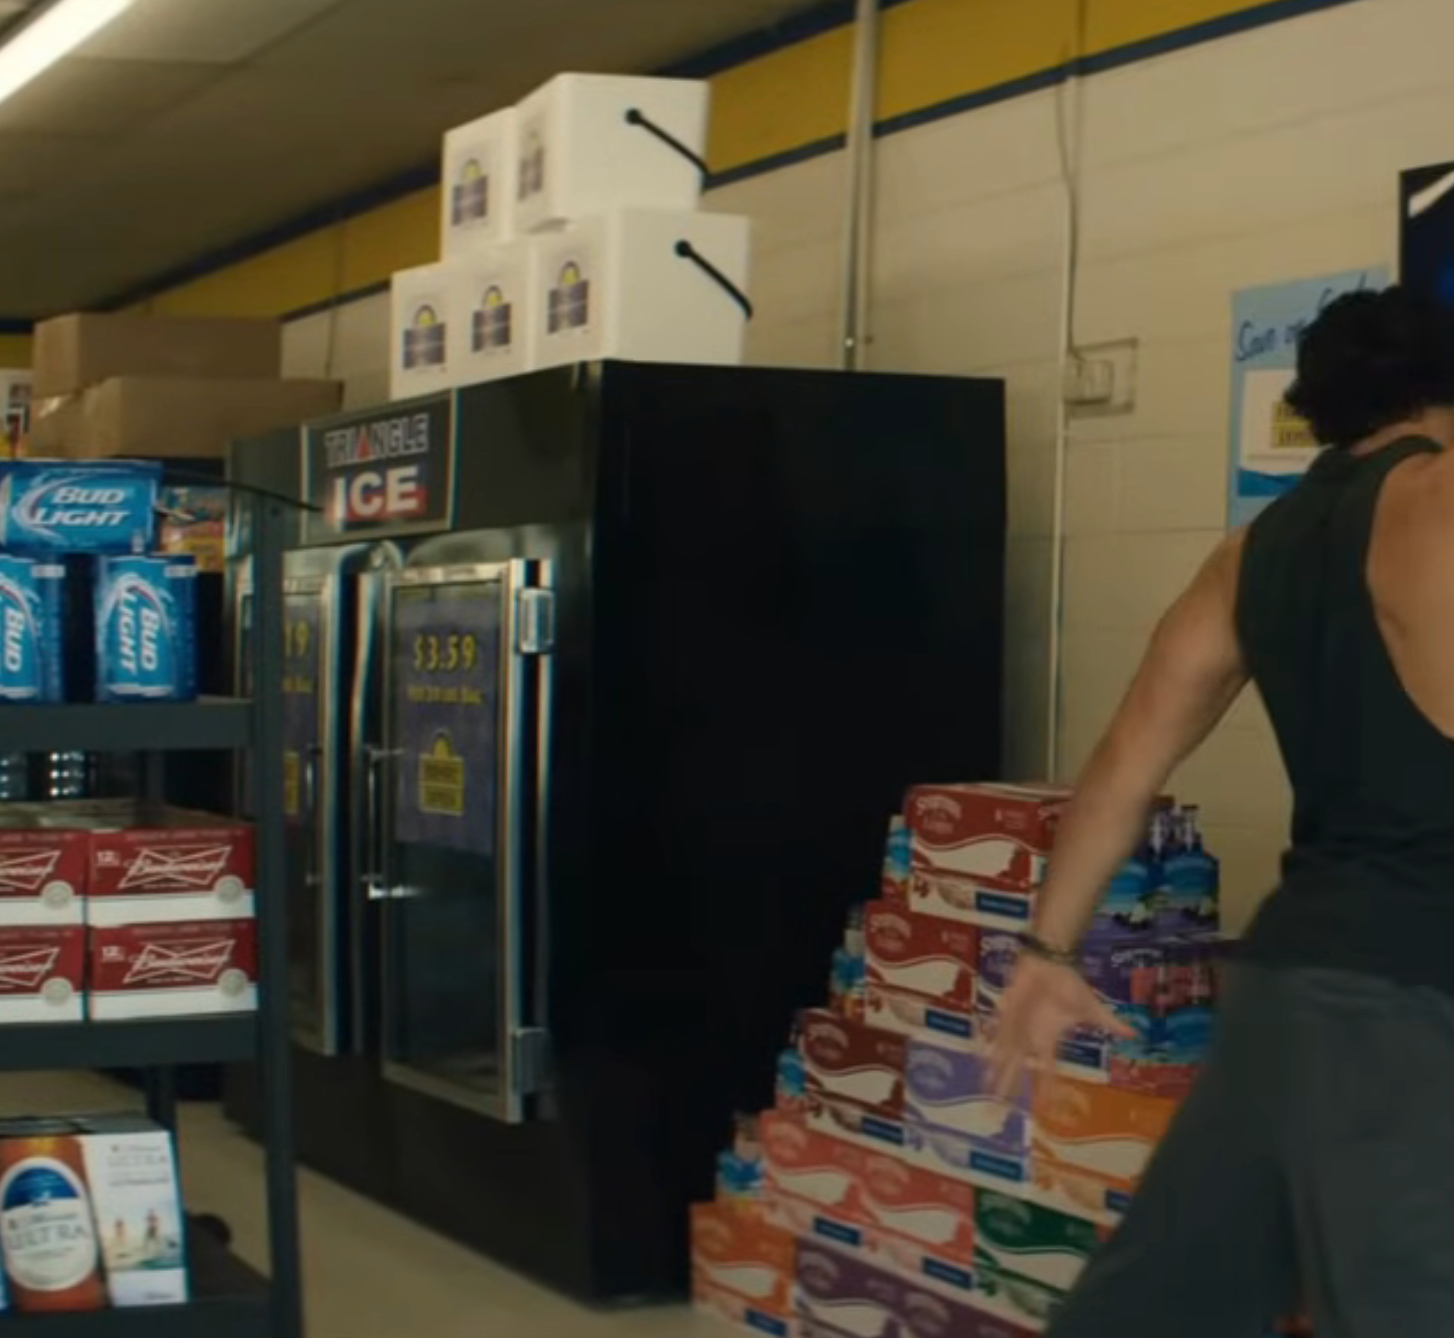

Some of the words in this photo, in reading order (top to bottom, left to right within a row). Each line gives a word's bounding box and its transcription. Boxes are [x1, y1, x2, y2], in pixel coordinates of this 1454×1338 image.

[324, 412, 430, 468] TRIANGLE
[32, 506, 131, 527] LIGHT
[51, 486, 126, 505] BUD
[333, 464, 420, 522] ICE
[4, 606, 25, 673] BUD
[118, 589, 138, 675] LIGHT
[139, 607, 159, 671] BUD
[413, 634, 476, 671] $3.59
